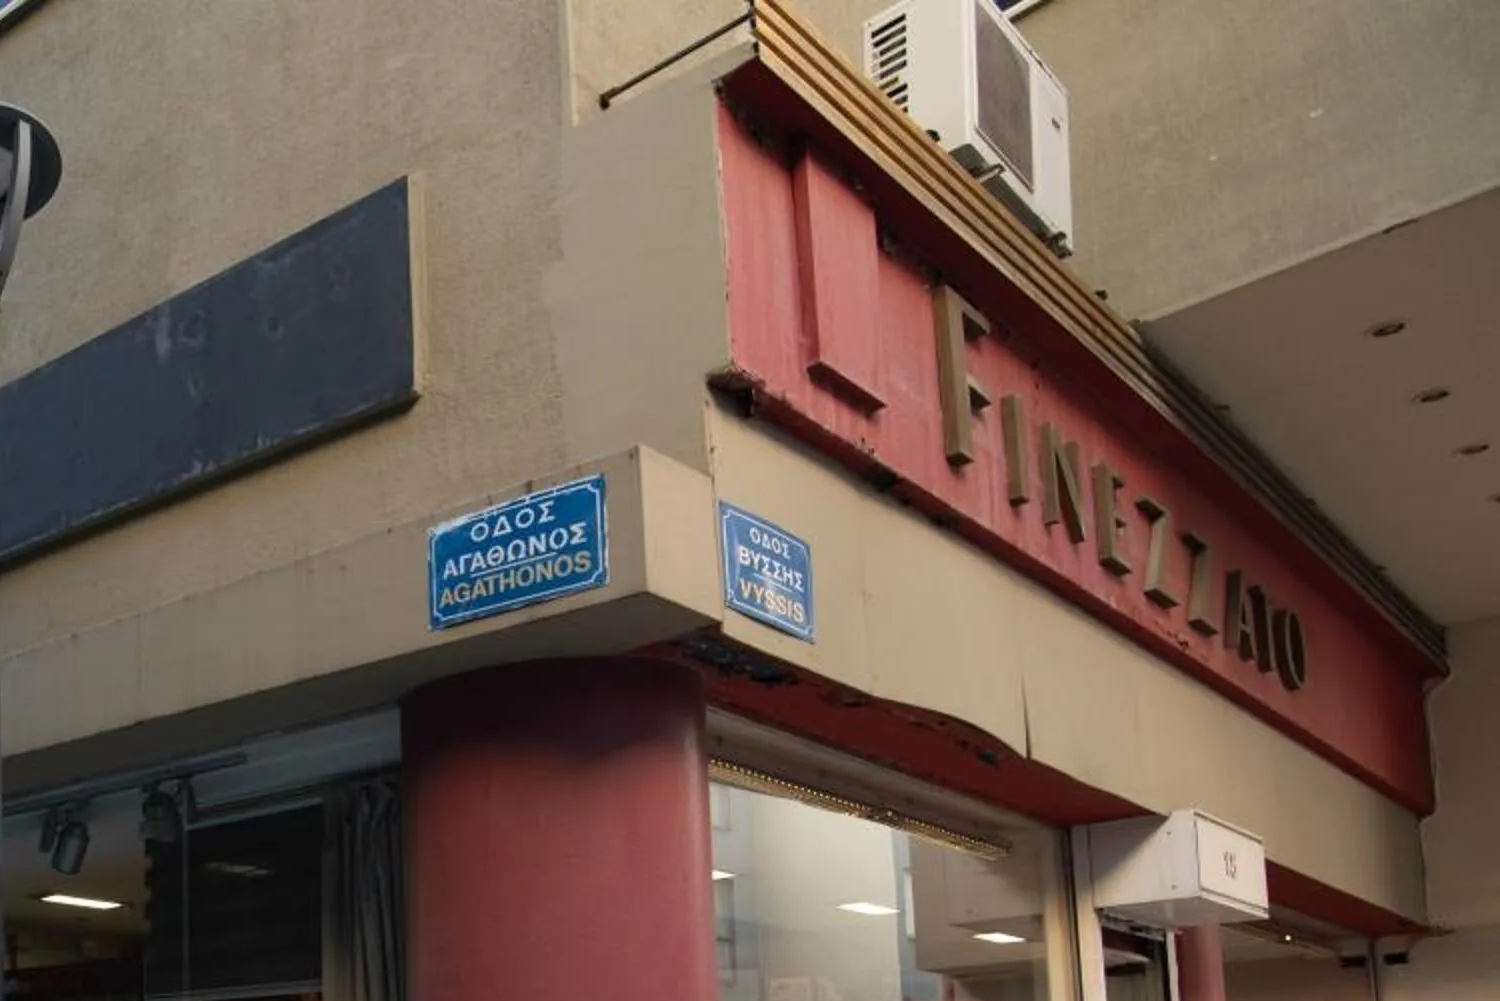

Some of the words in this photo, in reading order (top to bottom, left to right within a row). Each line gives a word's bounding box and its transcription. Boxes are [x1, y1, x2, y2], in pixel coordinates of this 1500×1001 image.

[470, 500, 556, 543] ΟΔΟΣ
[749, 527, 791, 559] ΟΔΟΣ
[443, 522, 587, 580] ΑΓΑΘΩΝΟΣ
[738, 546, 804, 593] ΒΥΣΣΗΣ
[438, 550, 592, 607] AGATHONOS
[738, 580, 805, 625] VYSSIS
